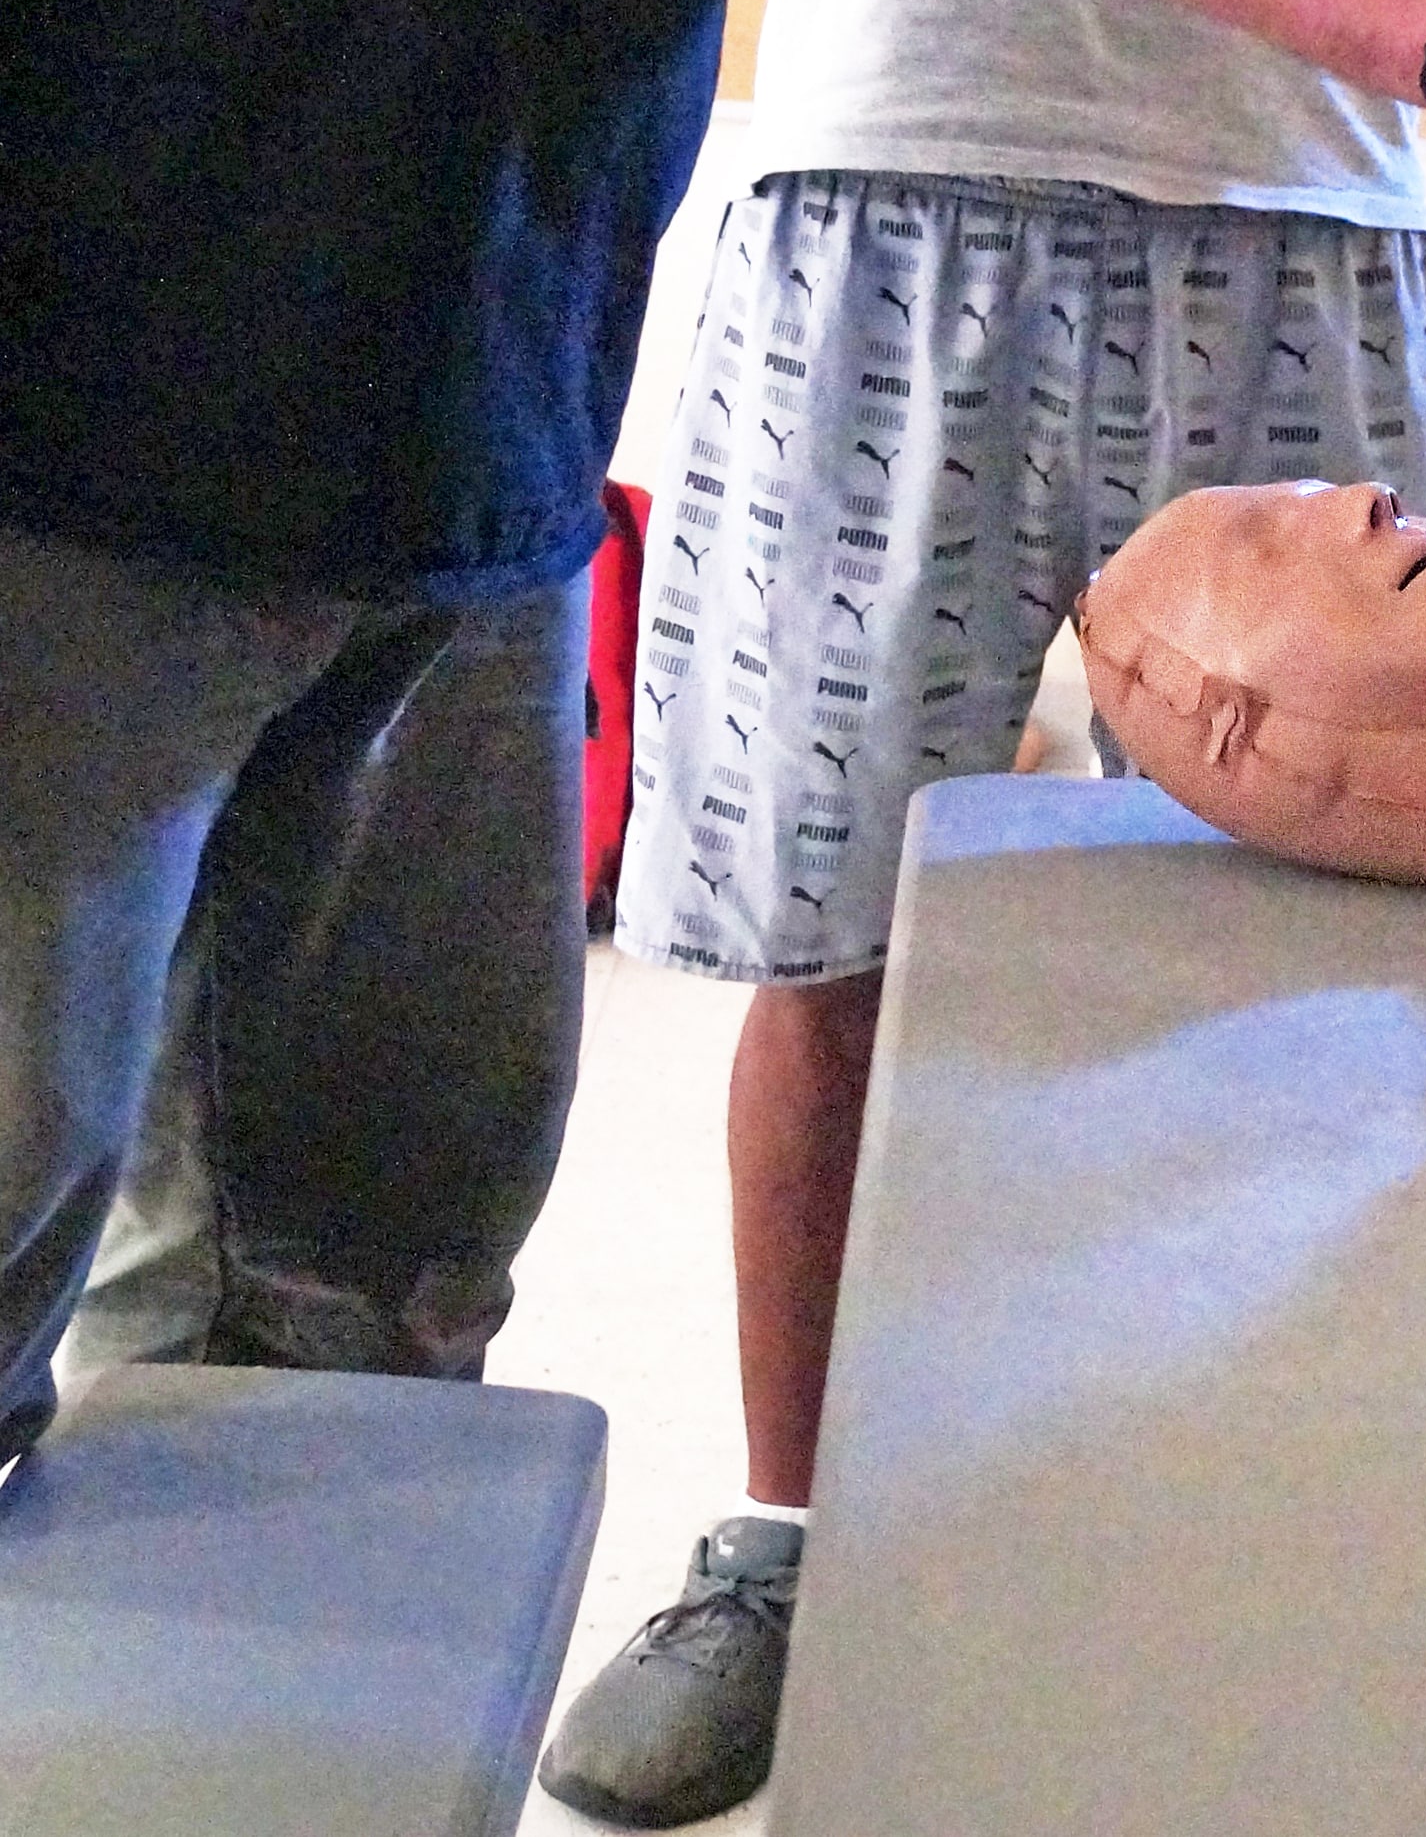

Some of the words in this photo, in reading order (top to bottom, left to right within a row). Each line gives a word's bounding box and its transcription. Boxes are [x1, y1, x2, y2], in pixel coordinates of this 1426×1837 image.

[764, 353, 807, 380] PUMA
[861, 373, 911, 398] PUMA
[685, 470, 725, 498] PUMA
[837, 525, 889, 552] PUMA
[652, 617, 696, 646] PUMA
[732, 649, 768, 679] PUMA
[817, 676, 868, 702] PUMA
[702, 794, 748, 825] PUMA
[797, 822, 850, 843] PUMA
